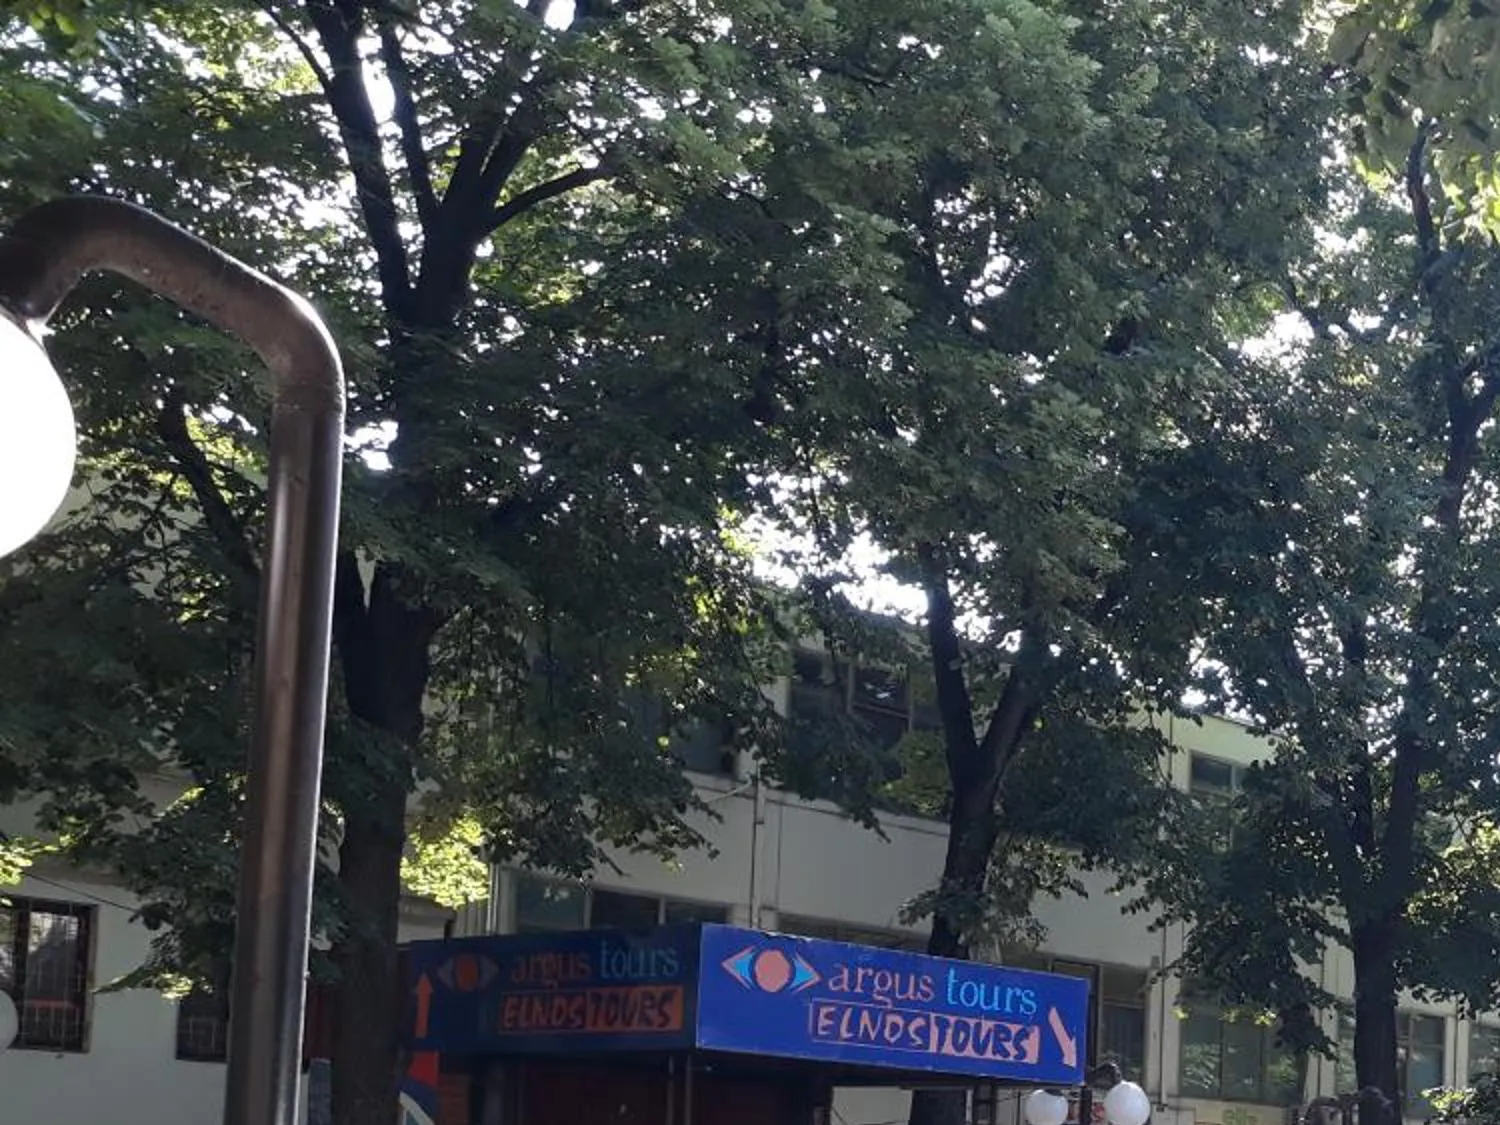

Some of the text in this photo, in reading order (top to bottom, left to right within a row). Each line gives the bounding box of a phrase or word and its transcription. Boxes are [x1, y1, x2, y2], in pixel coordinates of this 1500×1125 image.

[511, 941, 681, 991] argus tours
[827, 962, 1038, 1016] argus tours
[503, 988, 674, 1029] ELNOS TOURS
[817, 1006, 1033, 1061] ELNOS TOURS
